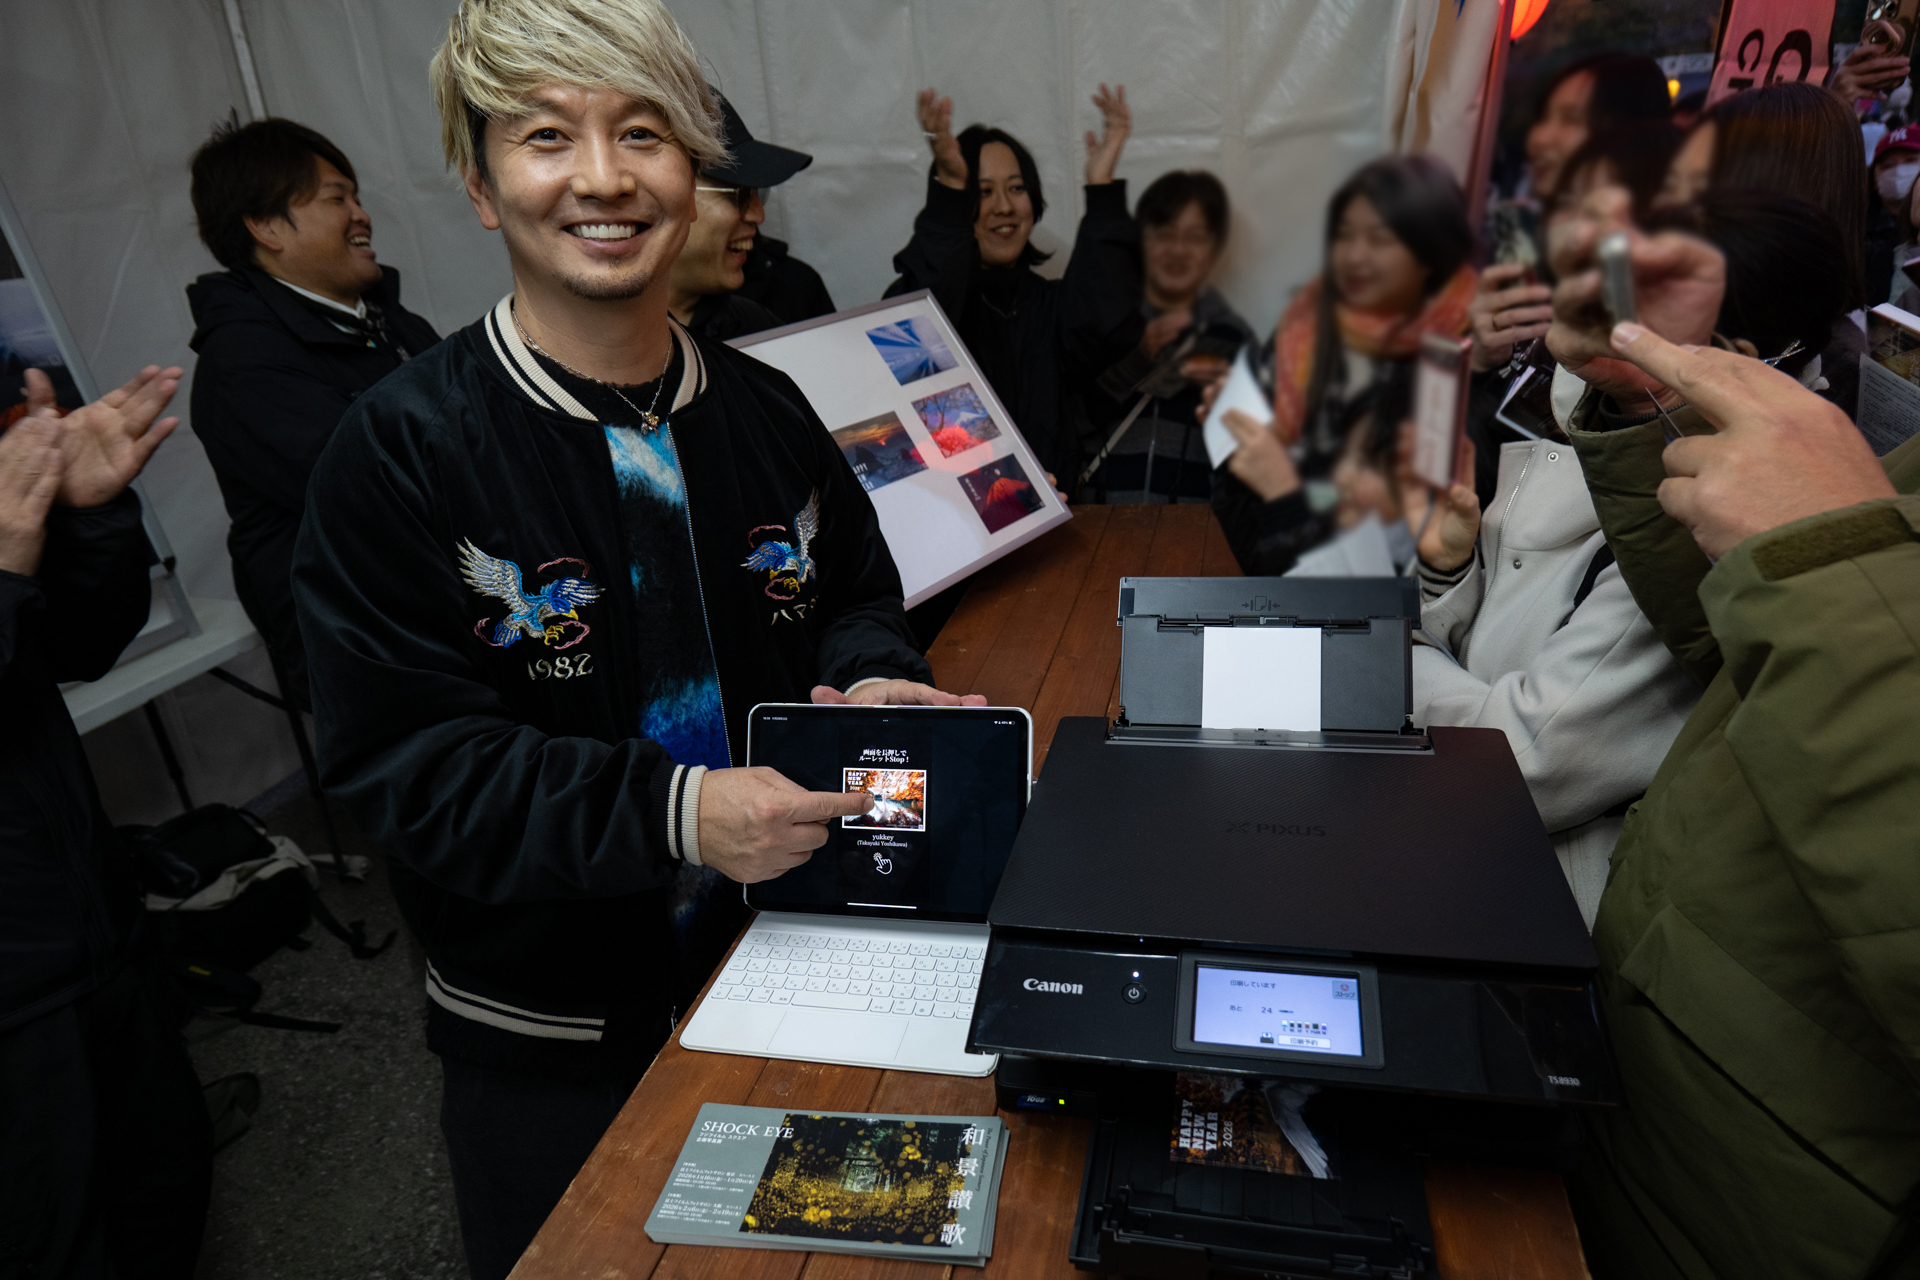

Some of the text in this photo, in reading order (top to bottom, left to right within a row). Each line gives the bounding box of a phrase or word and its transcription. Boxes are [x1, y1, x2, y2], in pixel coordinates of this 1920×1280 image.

[528, 653, 593, 680] 1982
[1257, 823, 1326, 837] PIXUS
[1023, 978, 1083, 994] Canon
[1230, 980, 1276, 989] 印刷しています
[1548, 1075, 1580, 1086] TS8930
[701, 1120, 794, 1138] SHOCK EYE
[1178, 1098, 1194, 1148] HAPPY
[1192, 1114, 1206, 1150] NEW
[1205, 1112, 1218, 1150] YEAR
[1222, 1120, 1234, 1148] 2026
